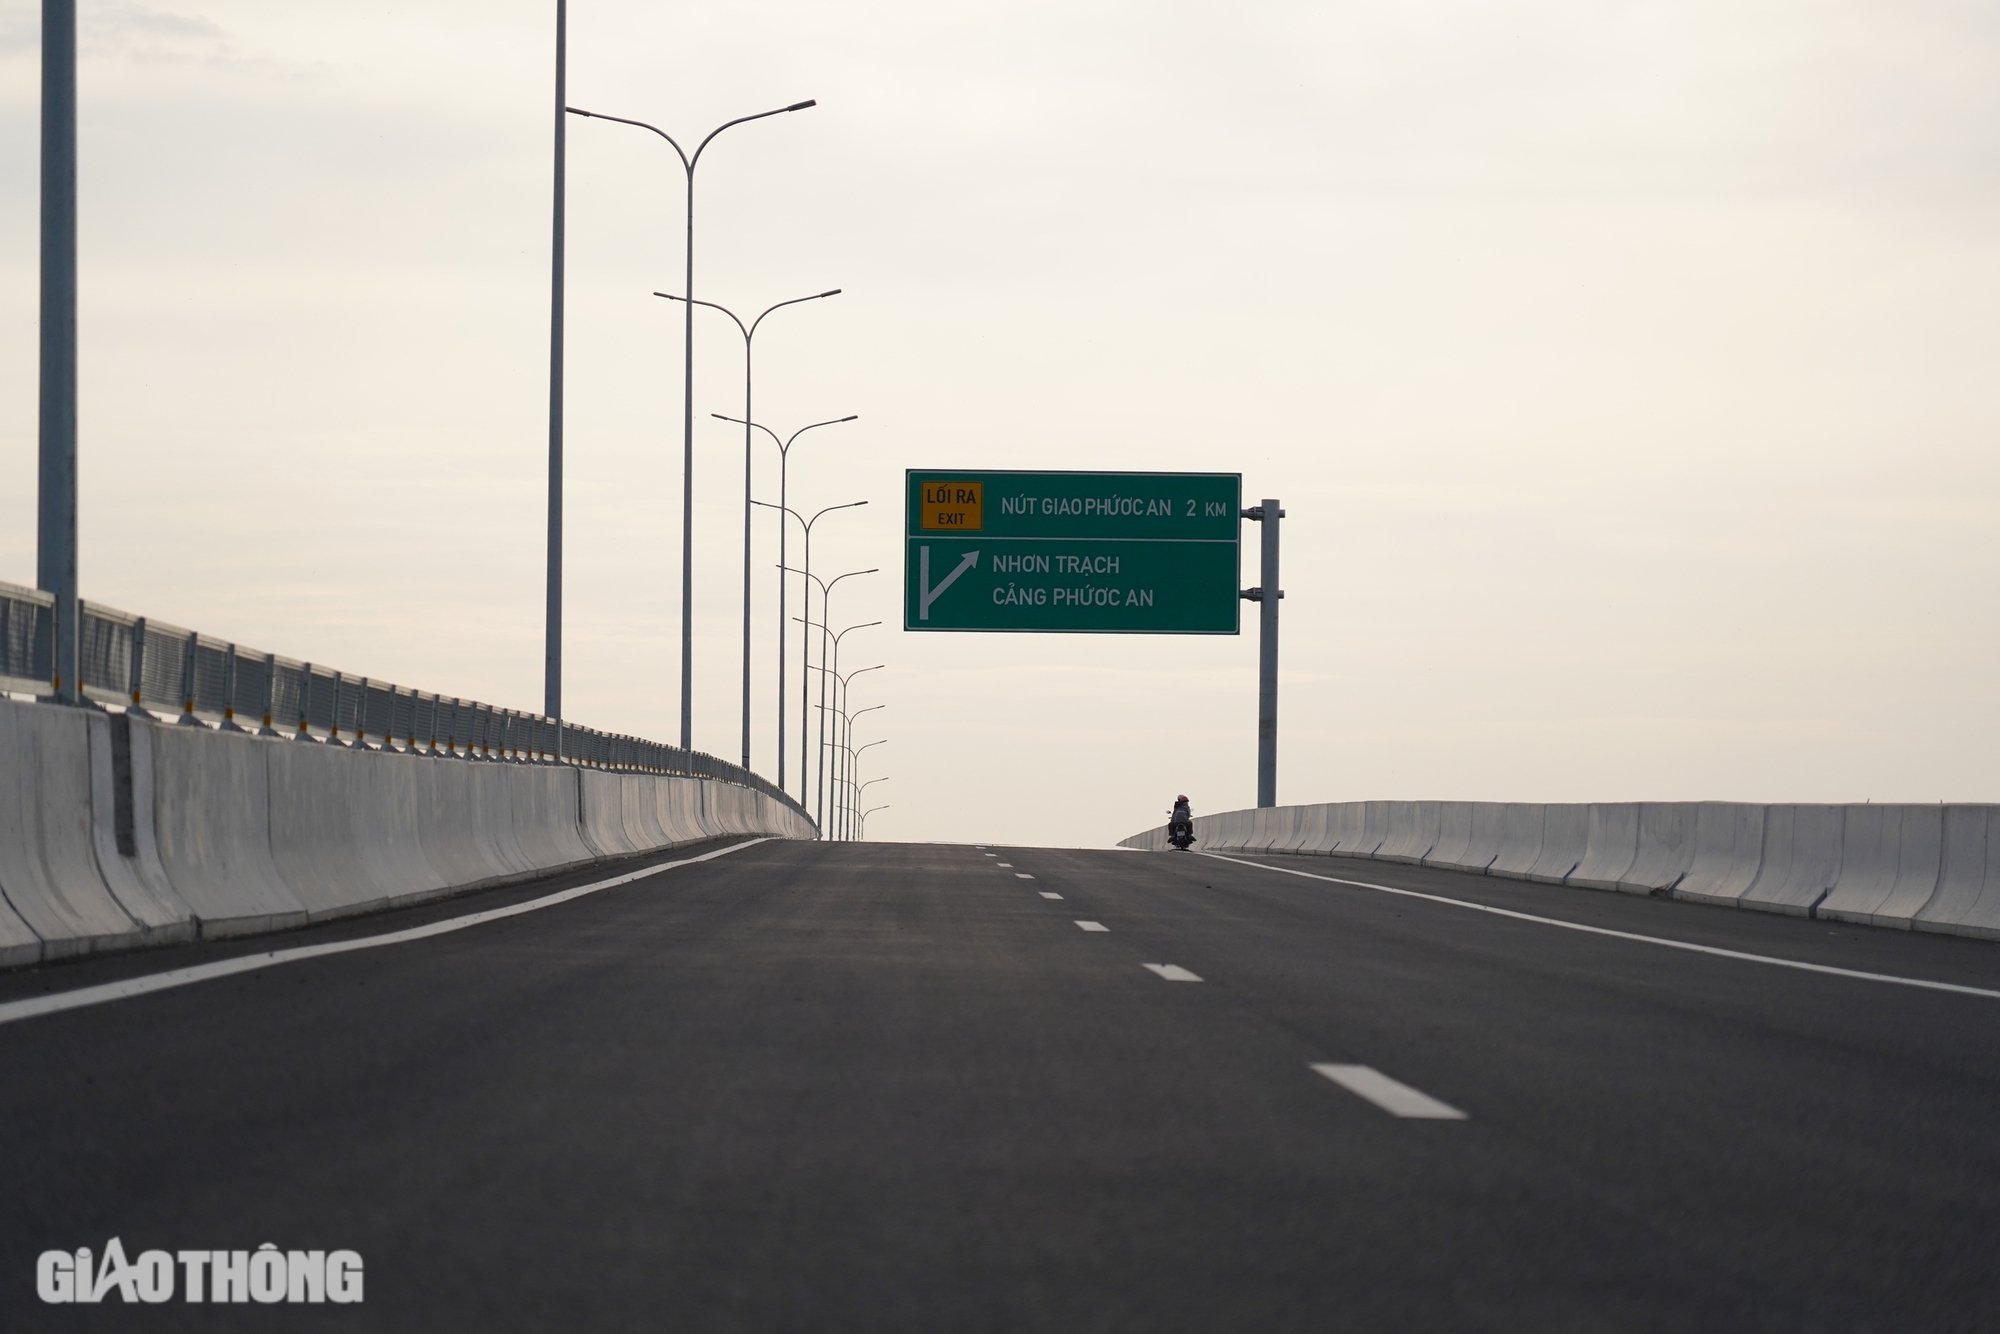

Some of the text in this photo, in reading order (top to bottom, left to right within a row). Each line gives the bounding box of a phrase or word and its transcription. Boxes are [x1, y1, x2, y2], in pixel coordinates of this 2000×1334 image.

[927, 483, 976, 504] LỐI RA
[1001, 493, 1037, 515] NÚT
[1041, 497, 1082, 515] GIAO
[1146, 499, 1171, 516] AN
[1186, 499, 1196, 517] 2
[1205, 502, 1227, 517] KM
[938, 513, 965, 525] EXIT
[993, 554, 1120, 577] NHƠN TRẠCH
[992, 582, 1047, 605] CẢNG
[1125, 589, 1153, 606] AN
